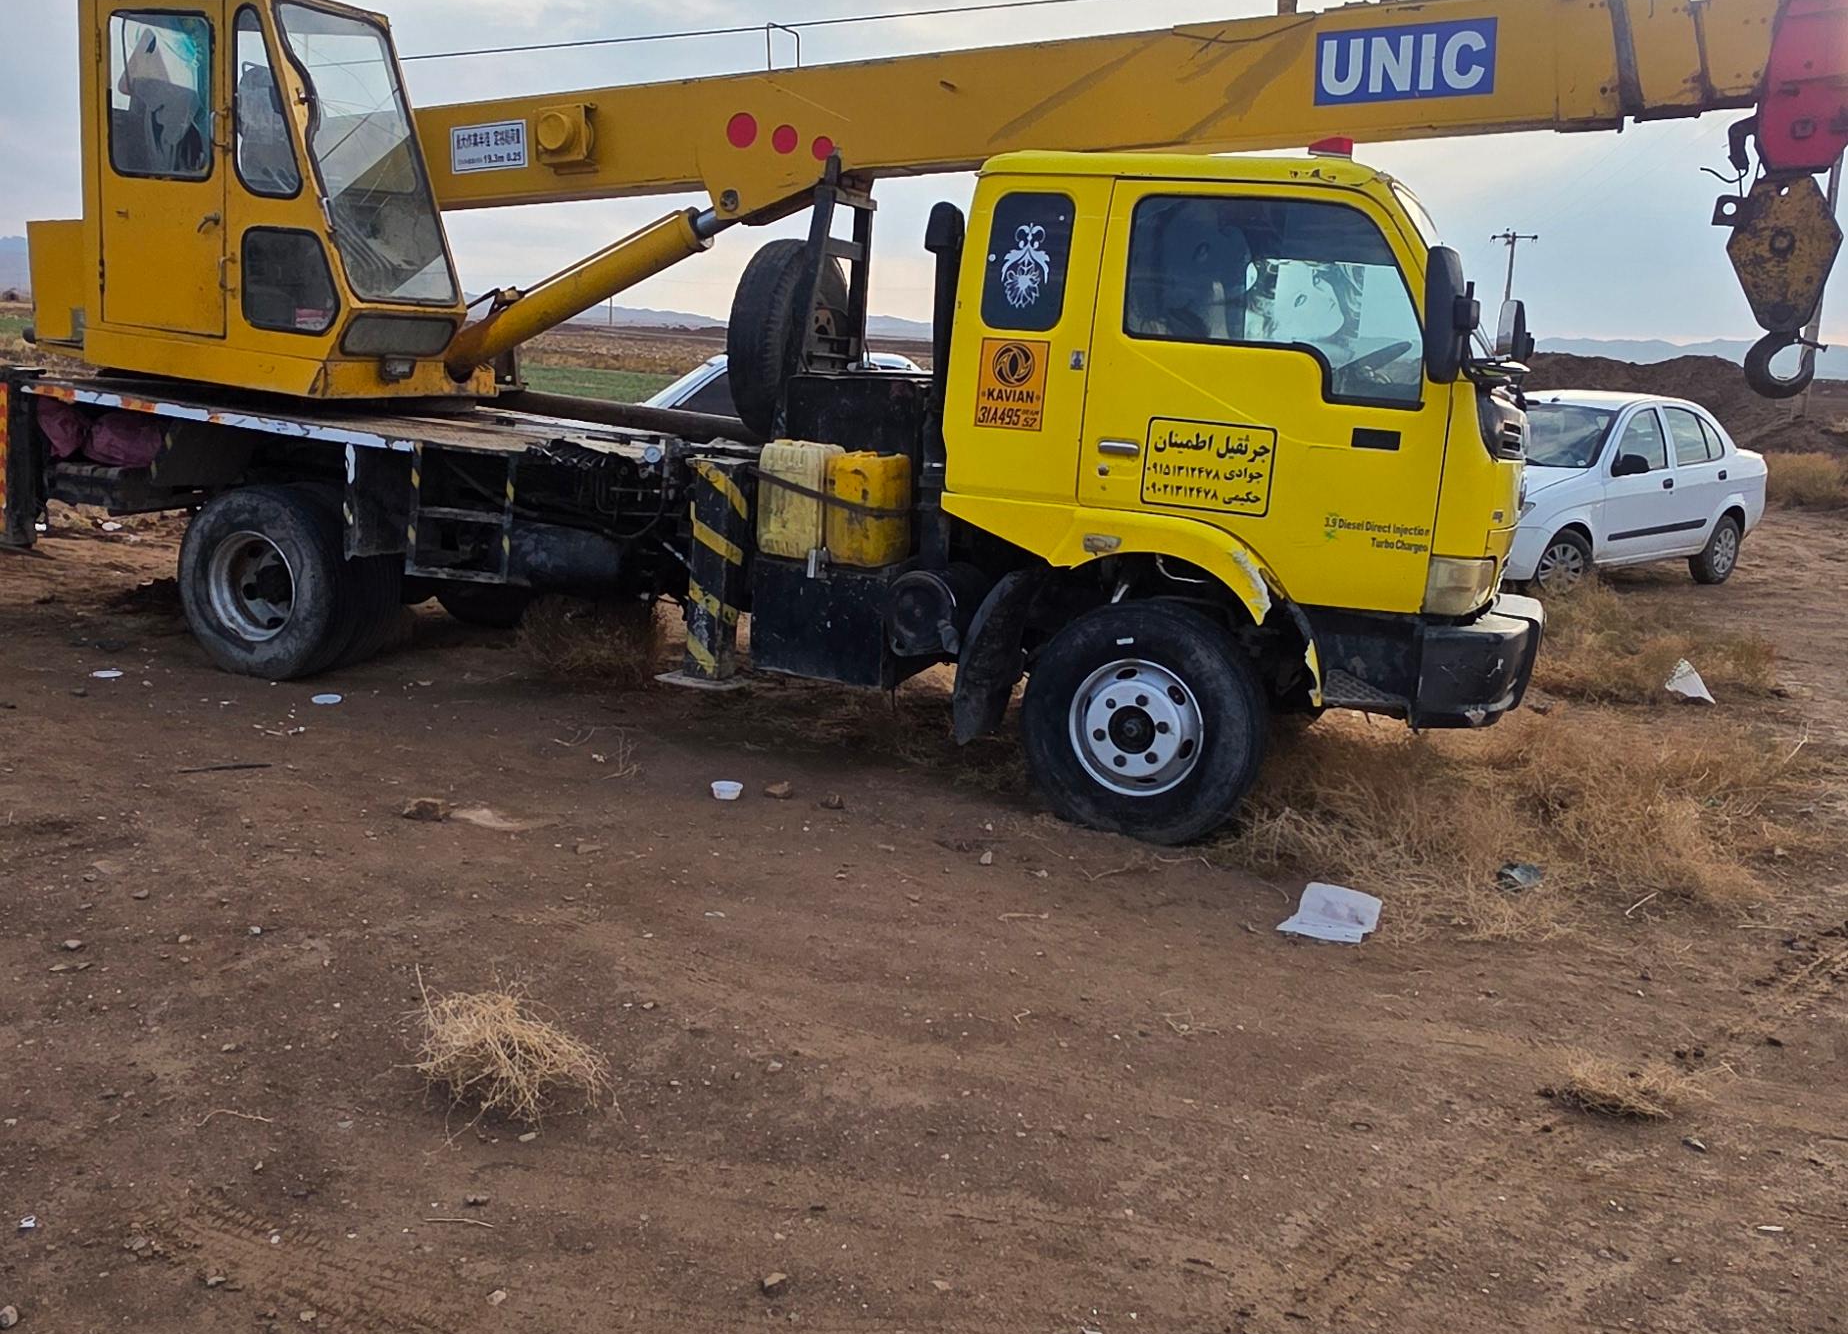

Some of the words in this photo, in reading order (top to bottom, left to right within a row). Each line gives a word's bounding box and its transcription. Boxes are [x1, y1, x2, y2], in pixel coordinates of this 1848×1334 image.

[1321, 30, 1487, 96] UNIC
[986, 387, 1035, 404] KAVIAN
[1153, 429, 1214, 455] اطمینان
[1216, 434, 1271, 464] جرثقیل
[1223, 466, 1264, 484] جوادی
[1222, 490, 1262, 506] حکیمی
[1338, 518, 1364, 531] Diesel
[1365, 521, 1391, 534] Direct
[1371, 537, 1395, 549] Turbo
